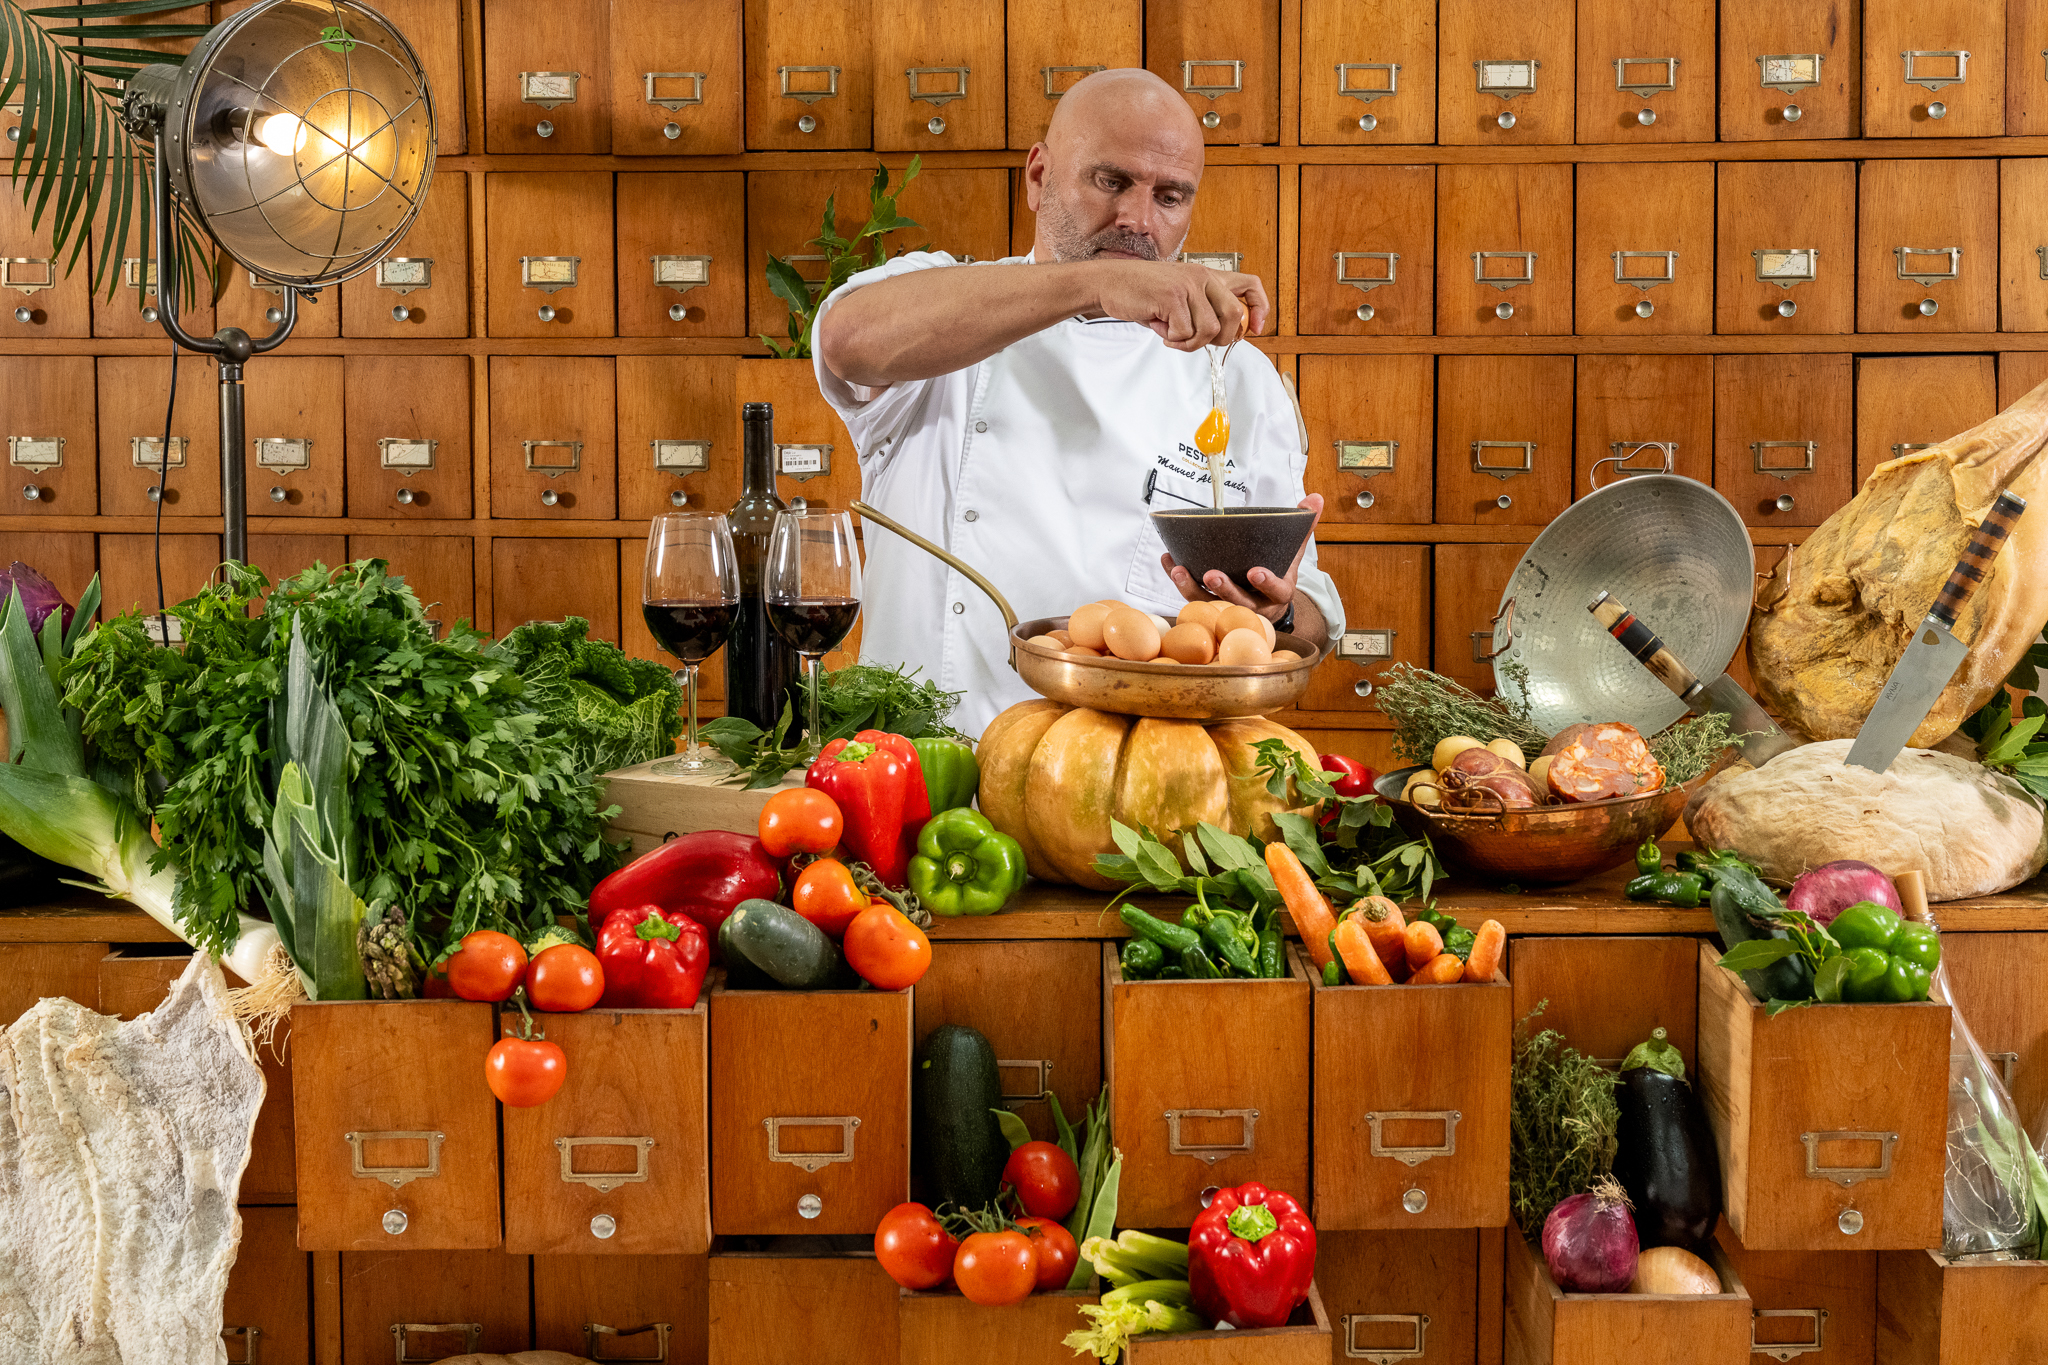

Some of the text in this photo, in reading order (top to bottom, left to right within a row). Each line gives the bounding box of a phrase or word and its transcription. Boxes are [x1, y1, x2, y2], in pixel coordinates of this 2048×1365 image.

[1157, 455, 1196, 480] Manuel
[1178, 442, 1236, 469] PESTA
[1353, 641, 1365, 651] 10
